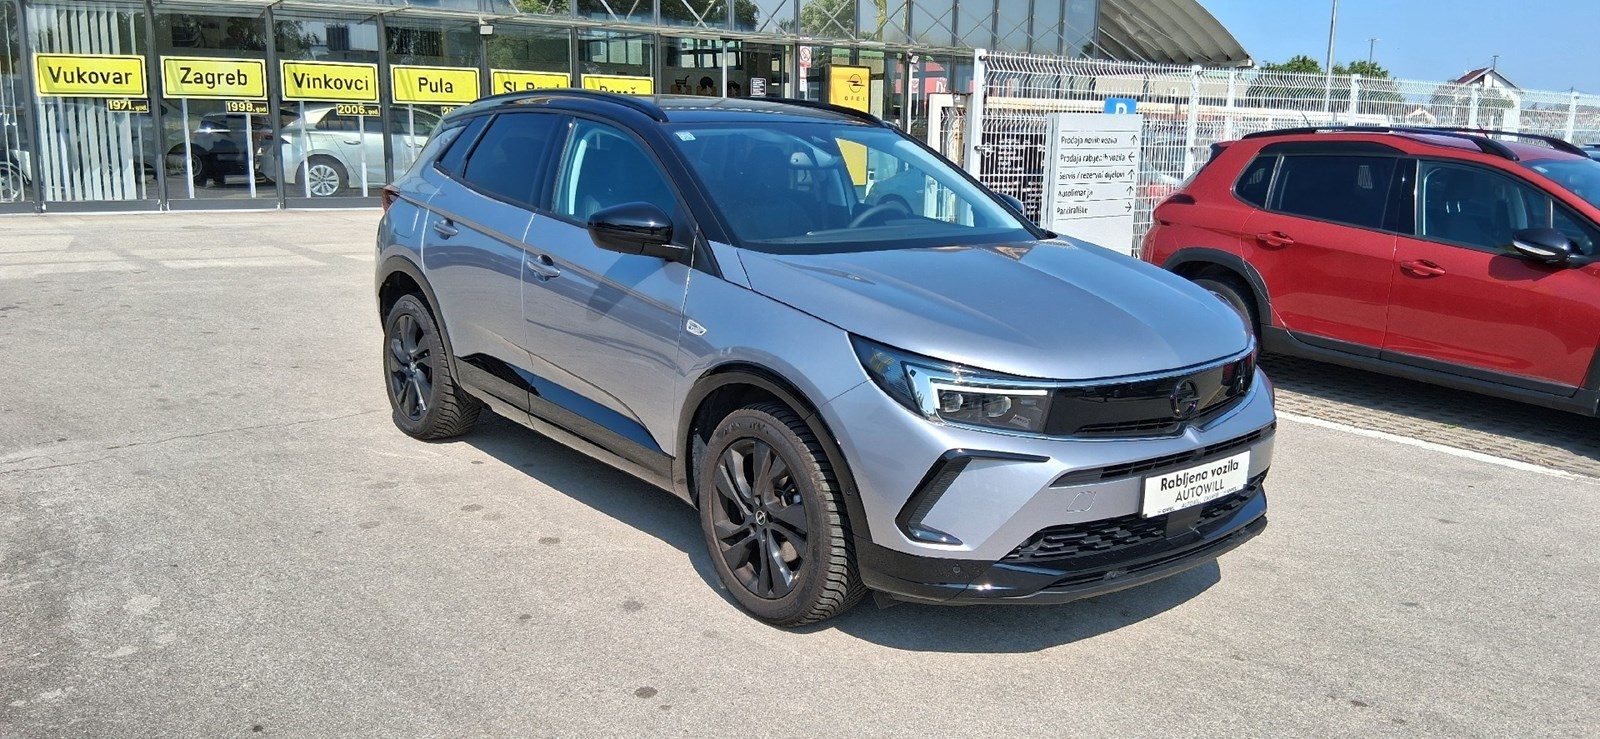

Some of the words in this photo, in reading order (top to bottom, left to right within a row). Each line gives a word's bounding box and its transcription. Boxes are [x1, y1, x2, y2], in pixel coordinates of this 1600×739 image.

[48, 66, 133, 85] Vukovar
[180, 67, 247, 89] Zagreb
[293, 72, 368, 91] Vinkovci
[418, 77, 453, 93] Pula
[1061, 136, 1083, 146] Prodaja
[1060, 154, 1082, 164] Prodaja
[1161, 470, 1208, 491] Rabljena
[1211, 459, 1239, 476] vozila
[1175, 479, 1224, 502] AUTOWILL
